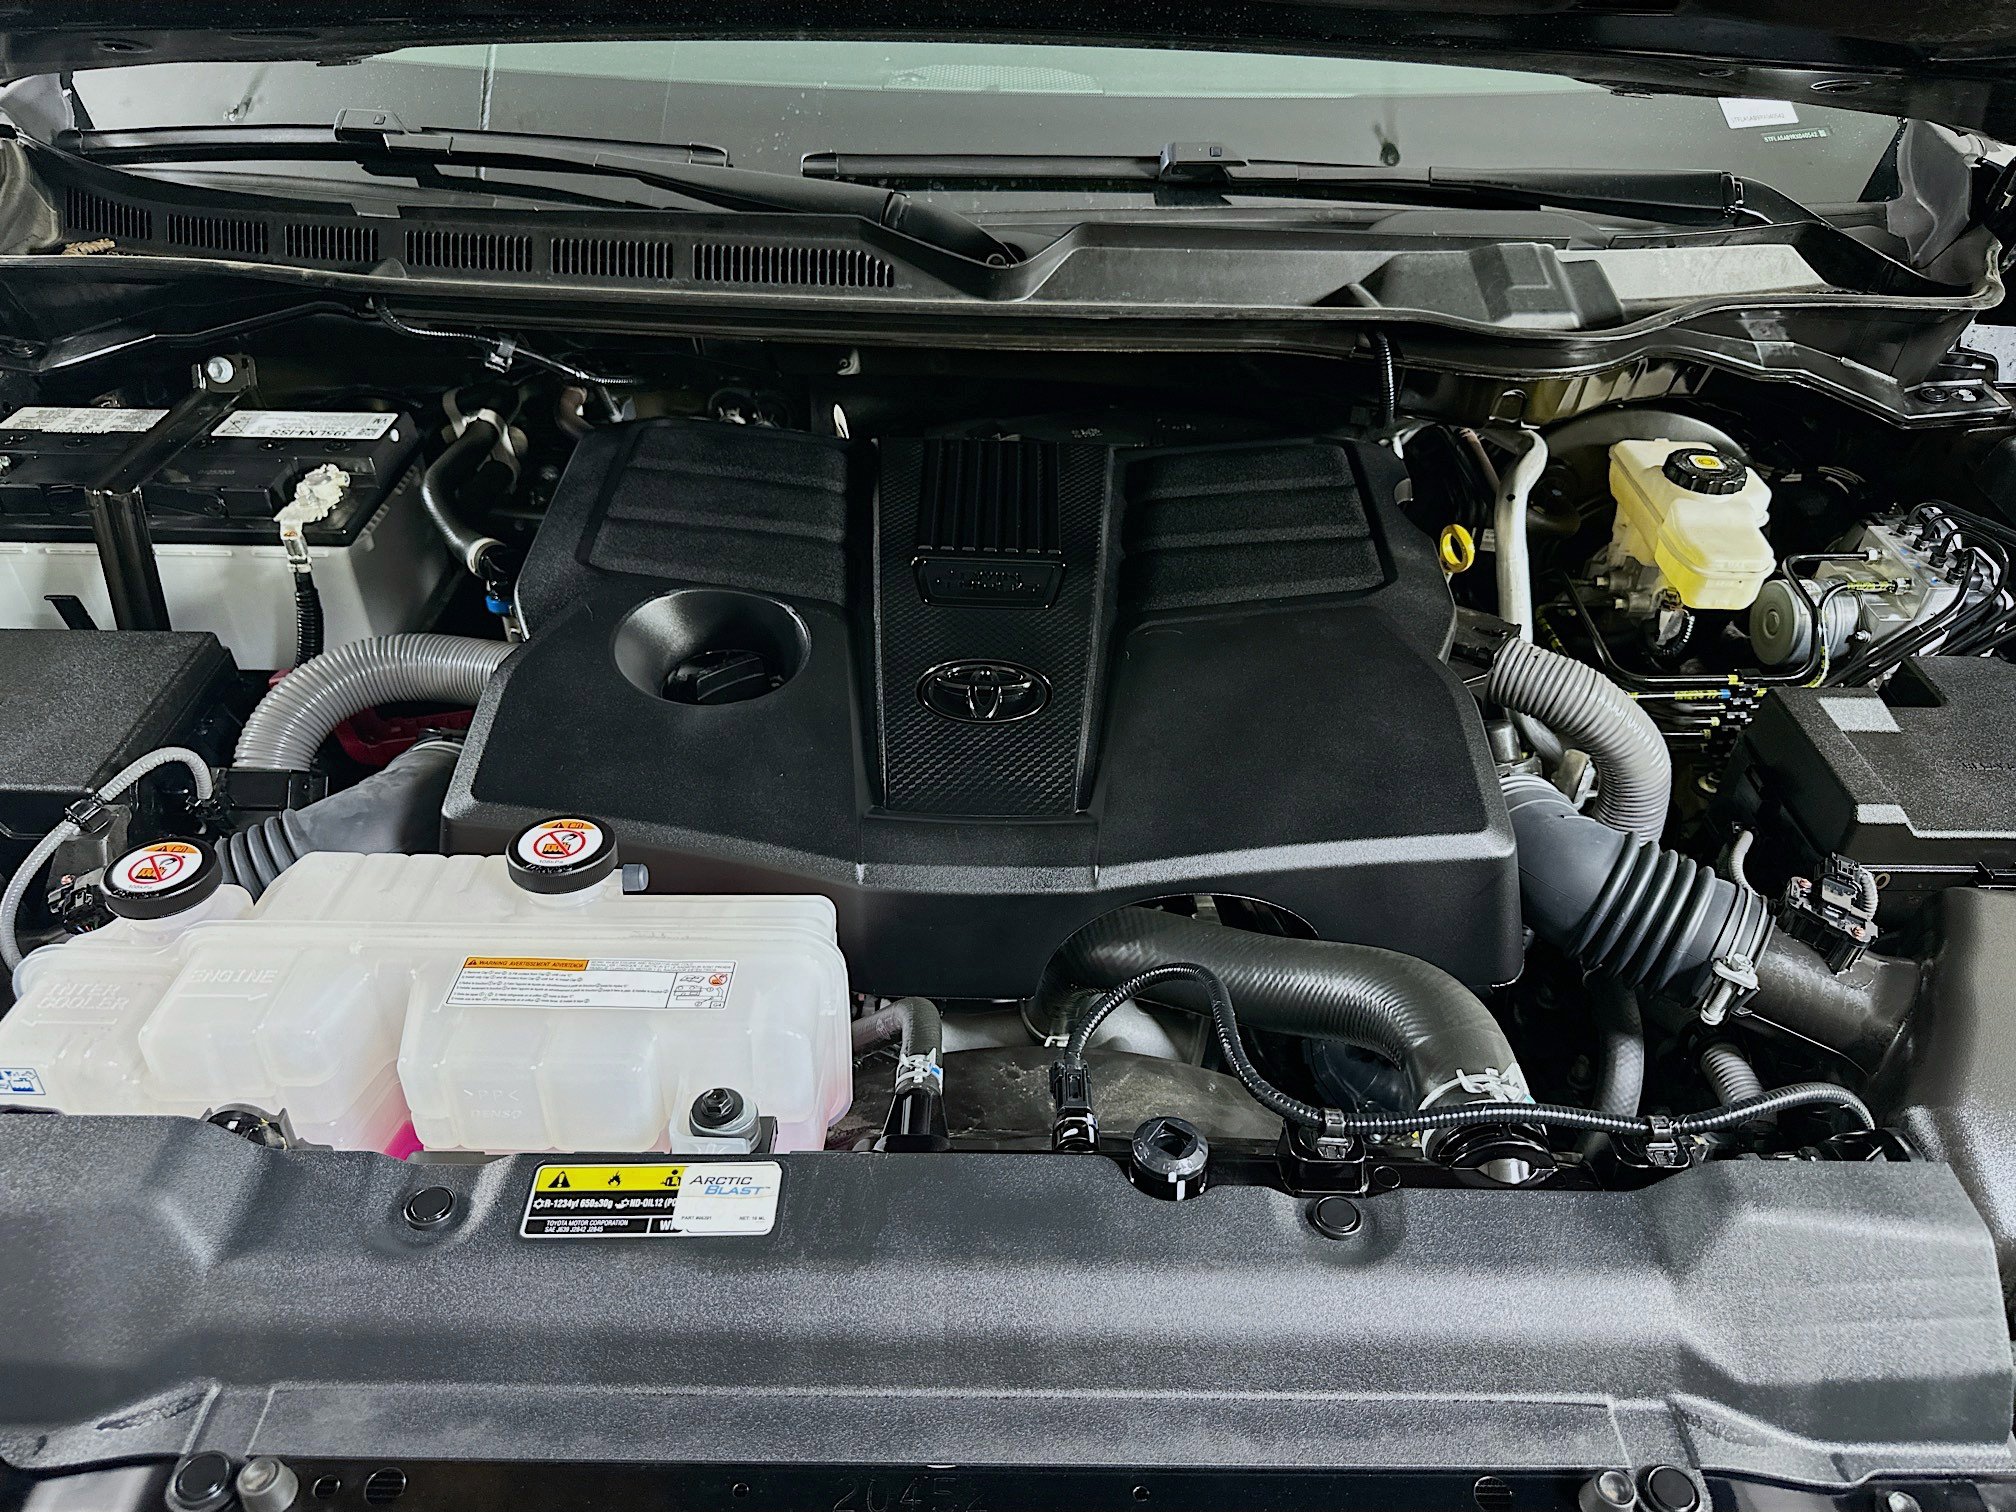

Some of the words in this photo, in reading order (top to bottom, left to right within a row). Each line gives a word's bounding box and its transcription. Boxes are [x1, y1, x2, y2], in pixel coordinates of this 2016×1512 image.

[190, 968, 279, 984] ENGINE
[689, 1175, 753, 1185] ARCTIC
[546, 1219, 568, 1227] TOYOTA
